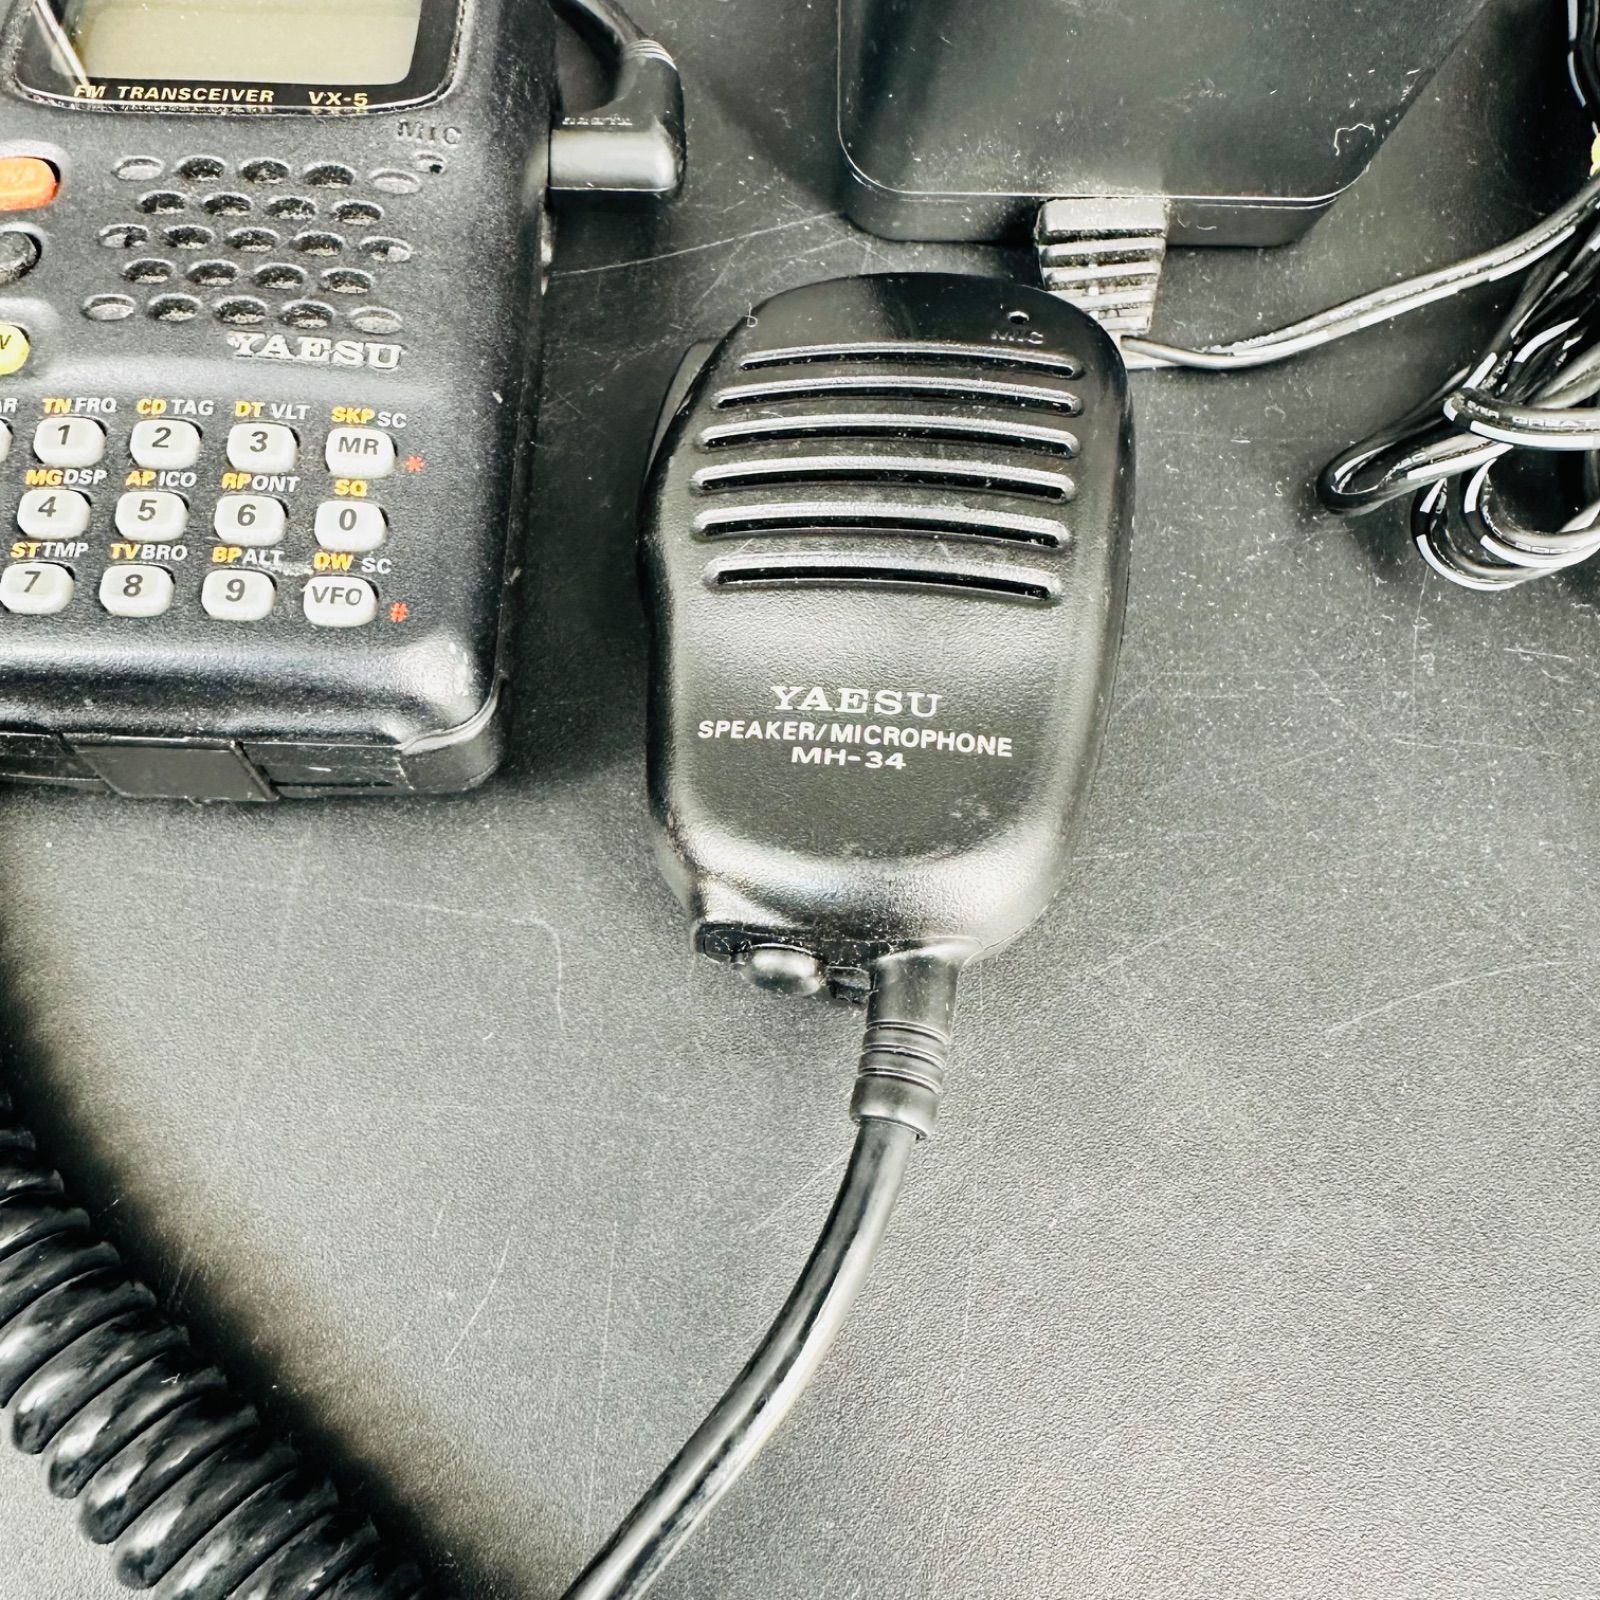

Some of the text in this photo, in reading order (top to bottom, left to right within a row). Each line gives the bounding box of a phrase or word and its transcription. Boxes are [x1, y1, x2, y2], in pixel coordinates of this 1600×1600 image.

[73, 85, 369, 107] FM TRANSCEIVER VX-5
[397, 120, 463, 145] MIC
[227, 331, 403, 370] YAESU
[74, 397, 118, 413] FRQ
[170, 399, 214, 416] TAG
[234, 400, 311, 420] DT VLT
[331, 406, 407, 429] SKP SC
[57, 424, 71, 445] 1
[152, 427, 171, 448] 2
[249, 430, 269, 453] 3
[338, 436, 379, 455] MR
[37, 496, 56, 518] 4
[137, 499, 157, 521] 5
[237, 503, 257, 526] 6
[338, 508, 358, 531] 0
[361, 557, 392, 574] SC
[24, 570, 42, 593] 7
[123, 574, 143, 598] 8
[225, 579, 246, 602] 9
[312, 585, 363, 606] VFO
[770, 685, 943, 718] YAESU
[697, 720, 1014, 757] SPEAKER/MICROPHONE
[791, 746, 907, 770] MH-34
